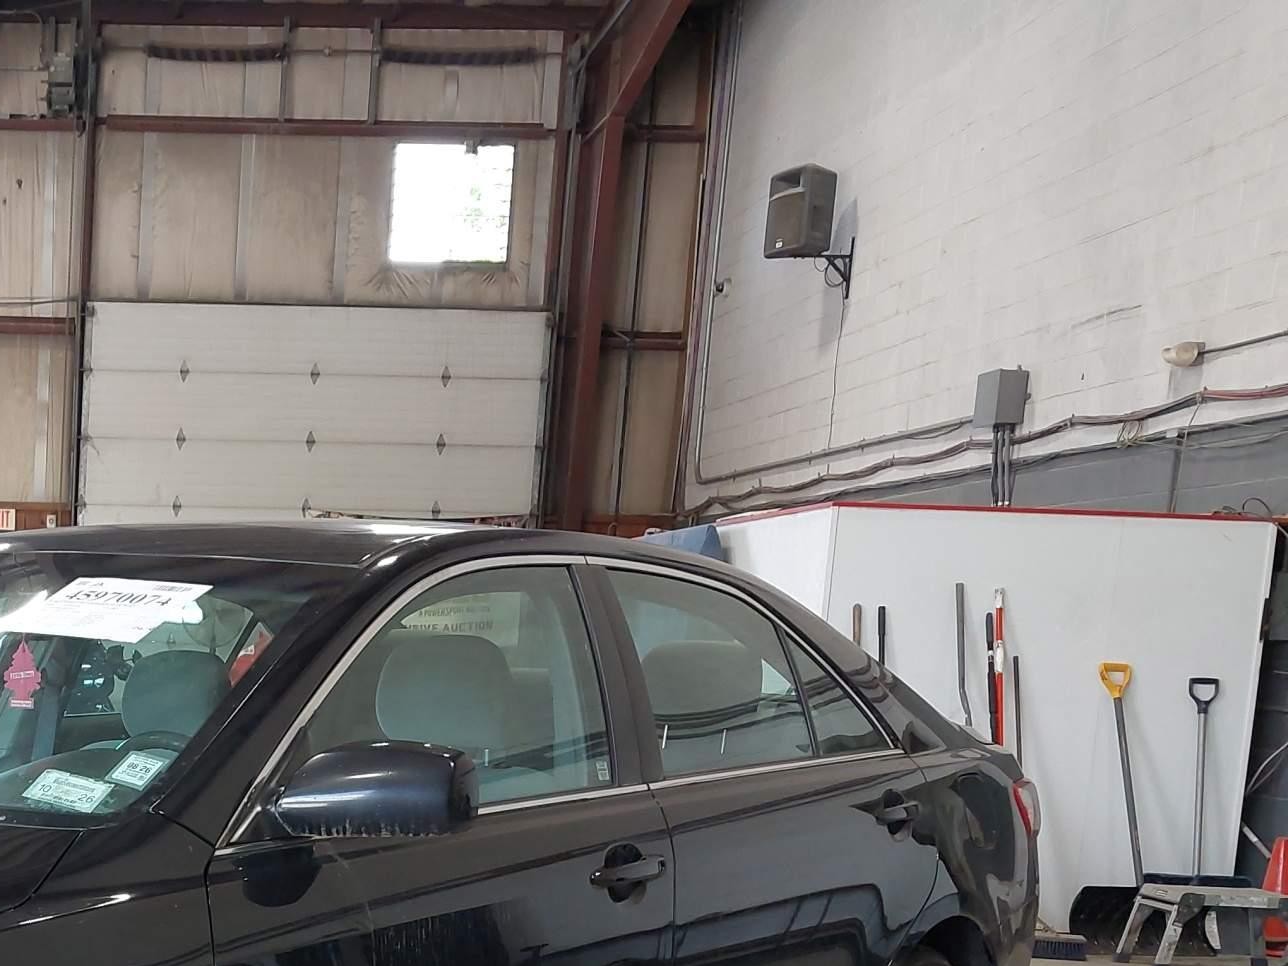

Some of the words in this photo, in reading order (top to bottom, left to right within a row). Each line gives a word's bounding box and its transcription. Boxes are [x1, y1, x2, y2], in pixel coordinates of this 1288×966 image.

[65, 590, 172, 606] 45970074
[443, 620, 493, 633] AUCTION
[127, 761, 139, 770] 08
[140, 765, 152, 774] 26
[38, 783, 52, 793] 10
[78, 793, 95, 803] 26
